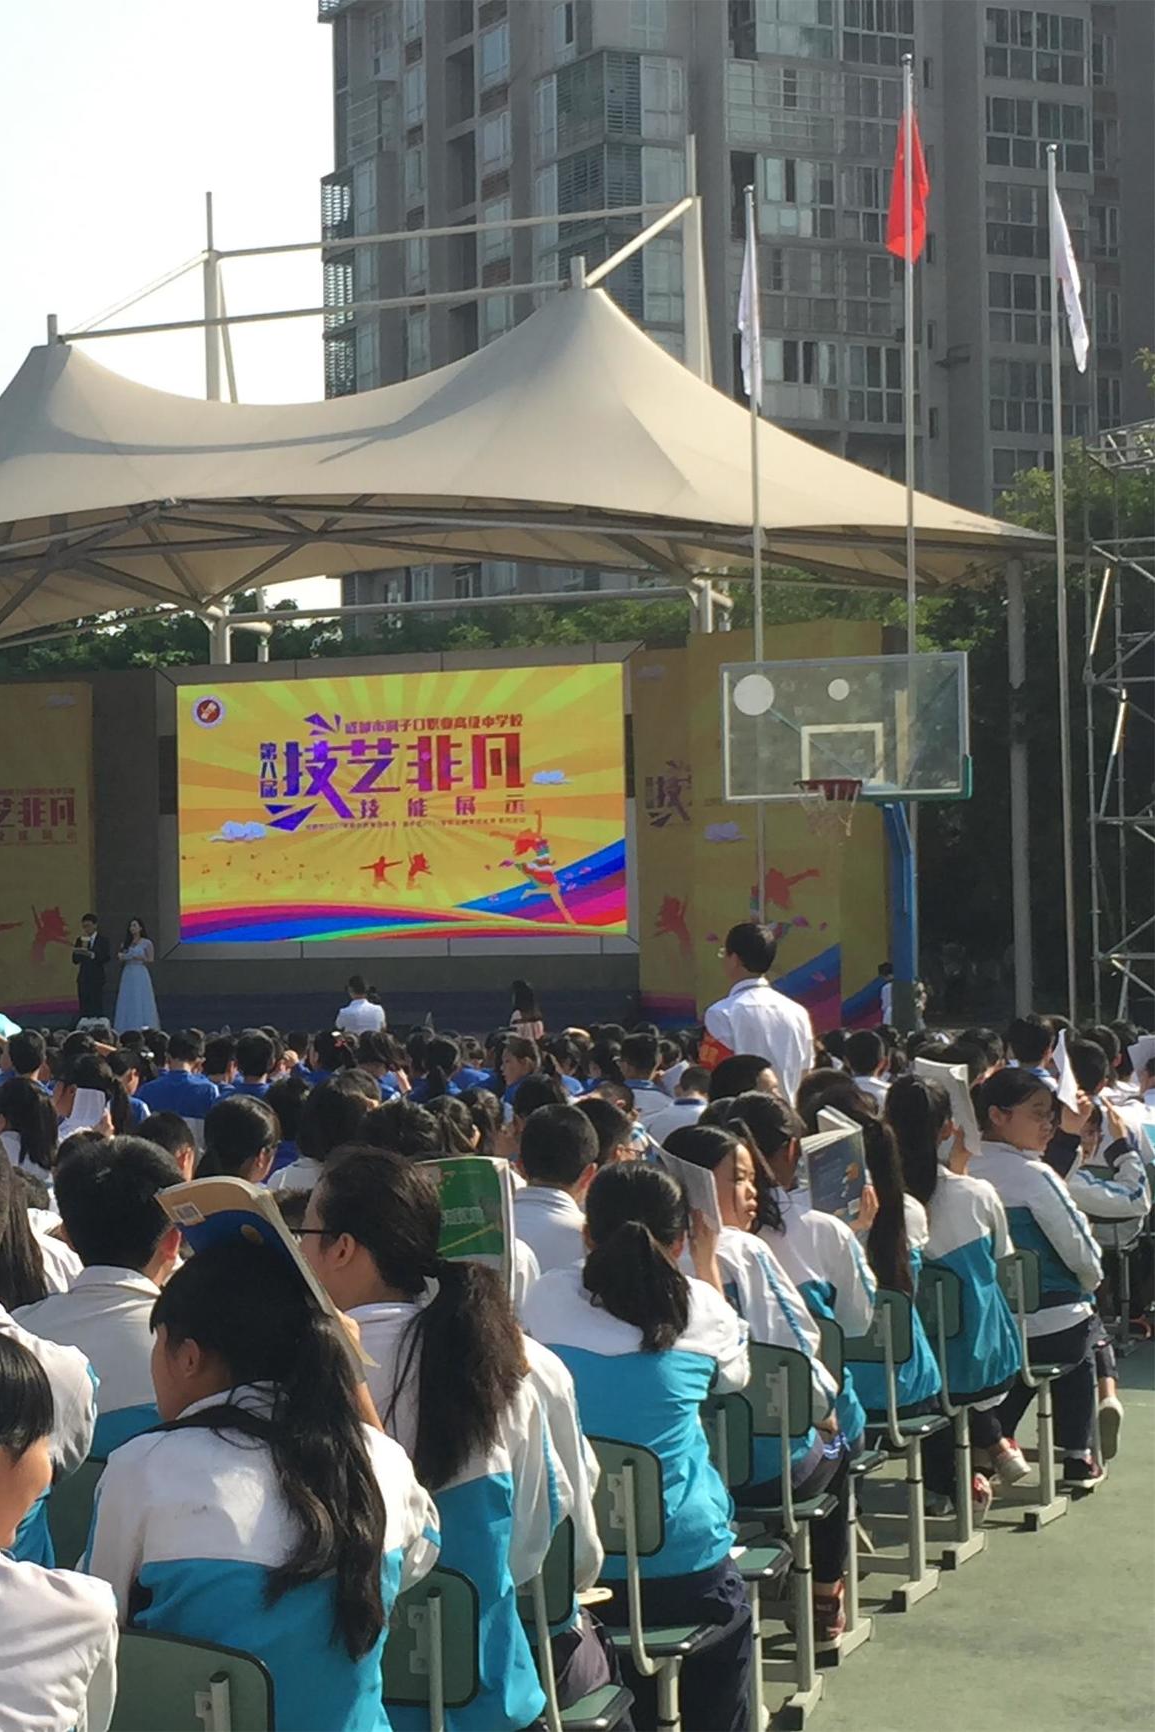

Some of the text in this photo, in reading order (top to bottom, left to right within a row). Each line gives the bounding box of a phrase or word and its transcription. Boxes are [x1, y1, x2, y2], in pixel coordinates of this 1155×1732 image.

[260, 743, 278, 798] 第八届
[283, 733, 526, 820] 技艺非凡
[360, 794, 526, 819] 技能展示
